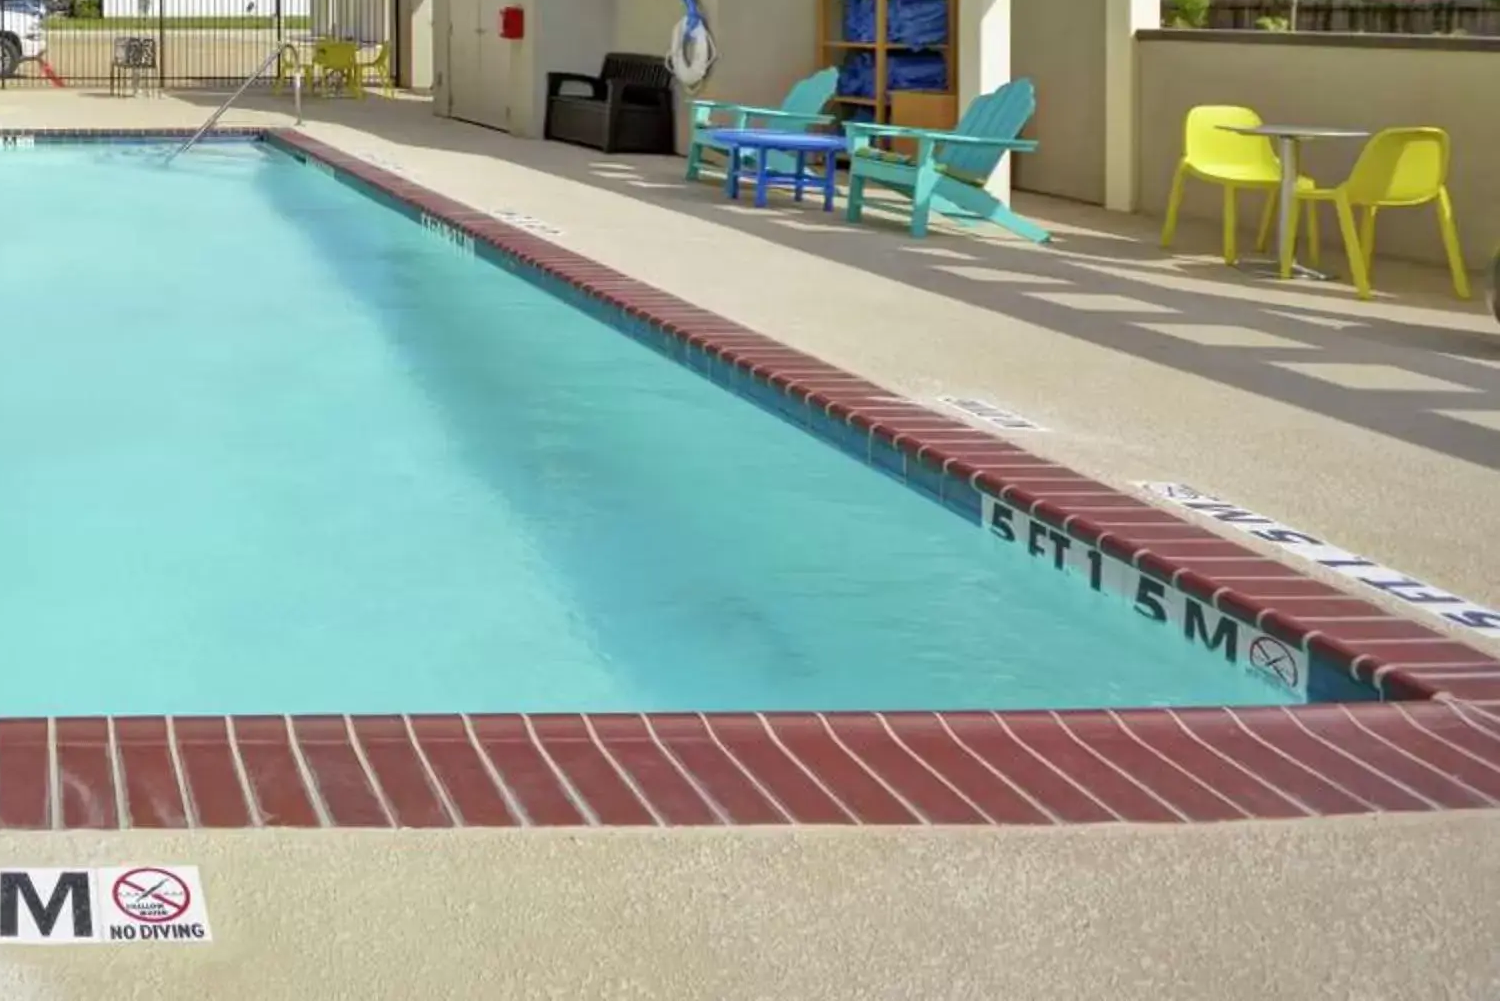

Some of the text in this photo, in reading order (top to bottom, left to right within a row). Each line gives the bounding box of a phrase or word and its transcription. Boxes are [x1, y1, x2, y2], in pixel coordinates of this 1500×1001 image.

[990, 501, 1015, 543] 5
[1027, 518, 1071, 572] FT
[1133, 574, 1169, 623] 5
[1184, 598, 1239, 663] M
[0, 871, 94, 938] M
[110, 923, 205, 940] NO DIVING
